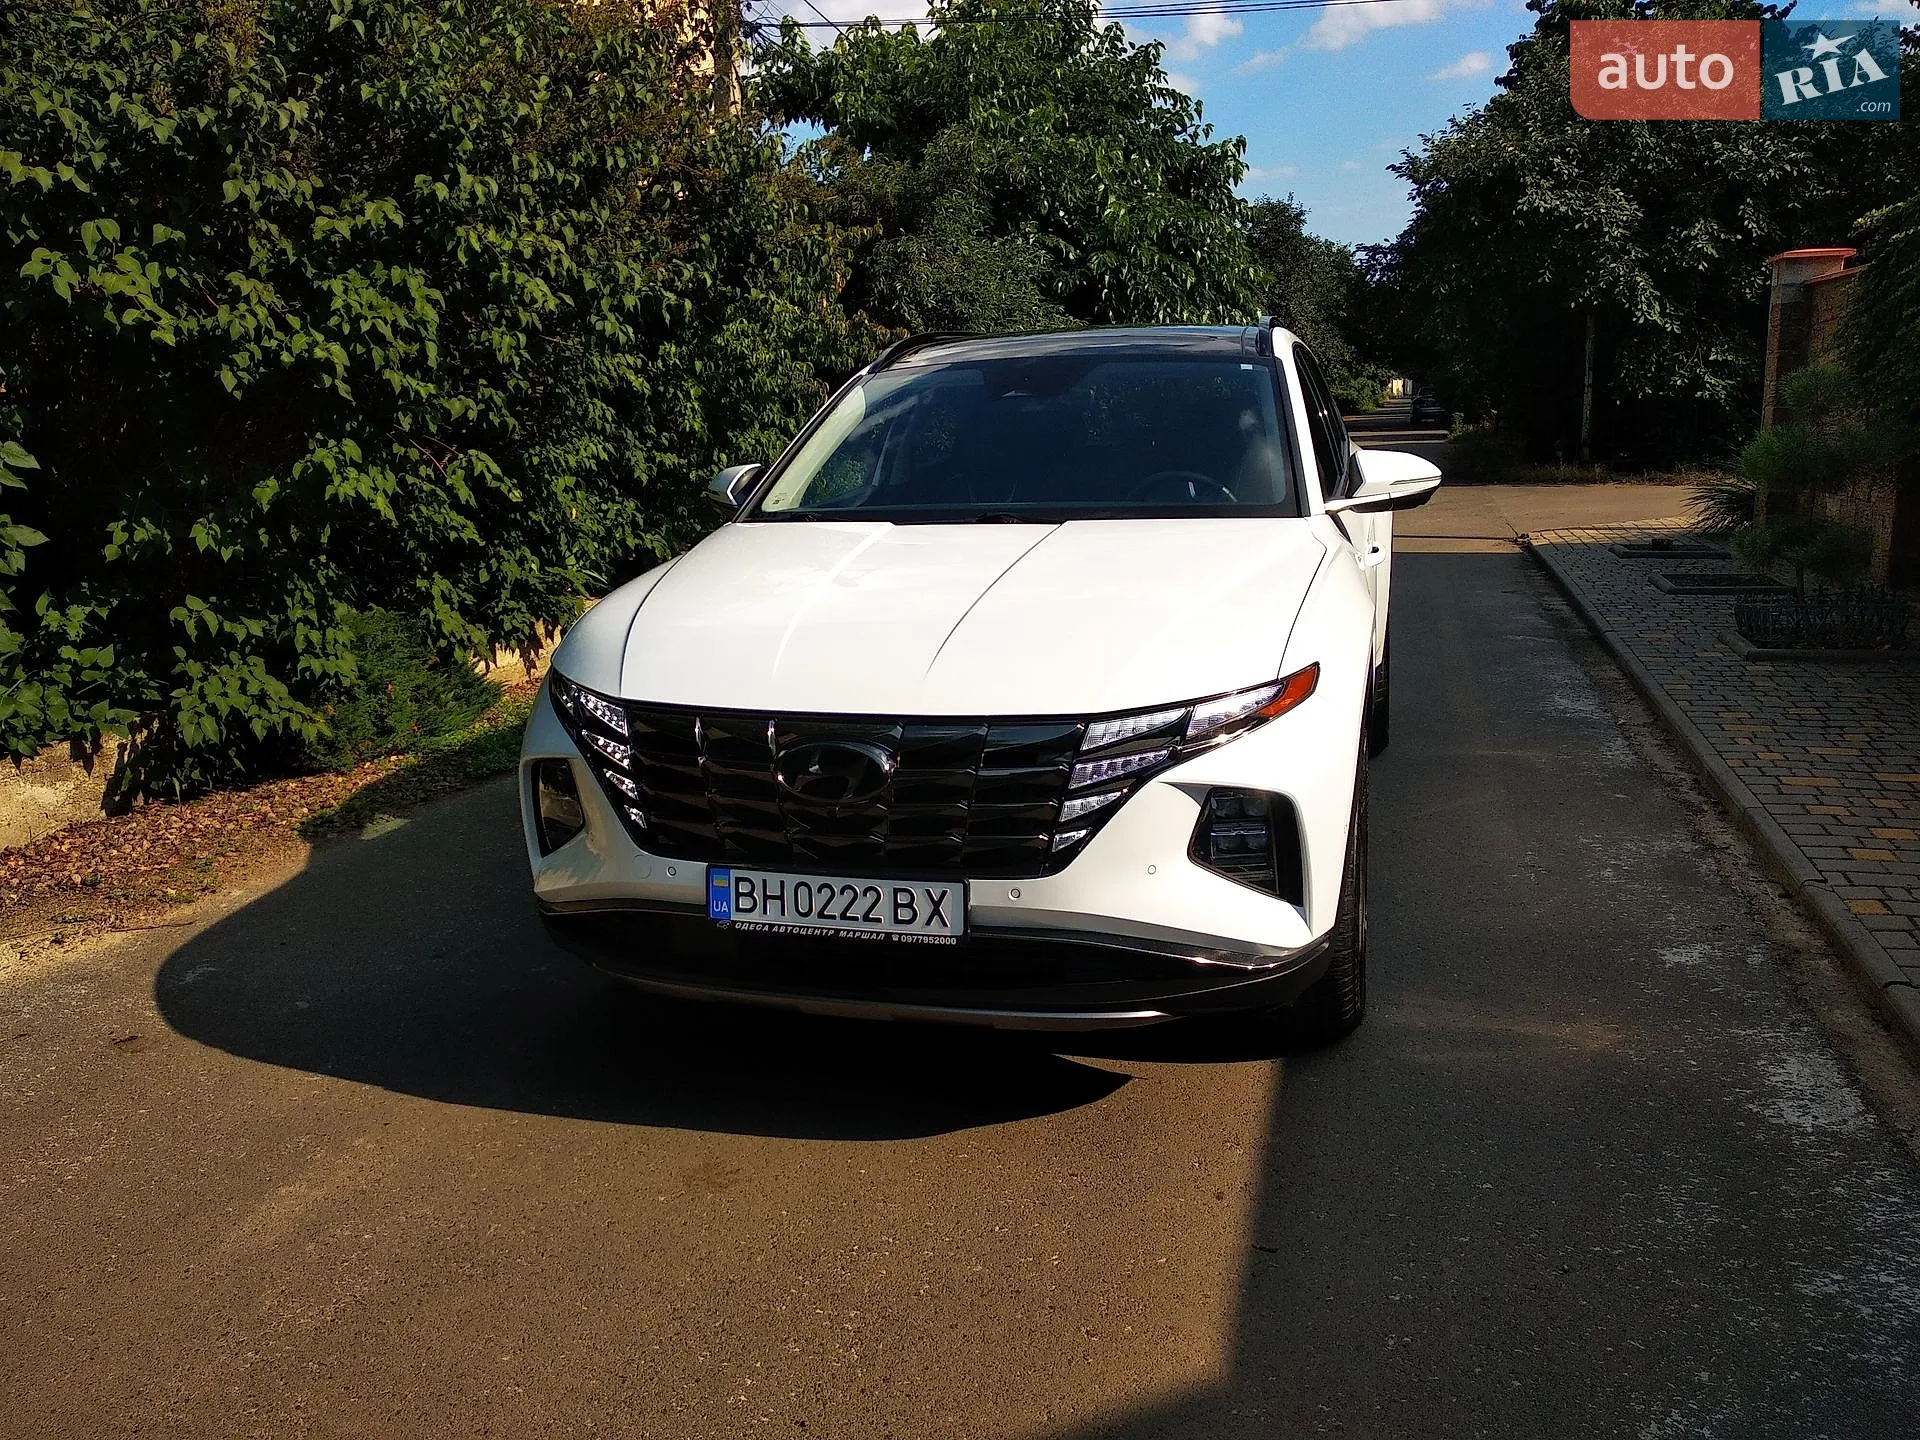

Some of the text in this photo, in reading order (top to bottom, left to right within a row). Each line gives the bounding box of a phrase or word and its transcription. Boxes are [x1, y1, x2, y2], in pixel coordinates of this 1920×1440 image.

[713, 900, 729, 914] UA
[734, 921, 886, 941] ОДЕСА АВТОЦЕНТР МАРШАЛ
[900, 935, 957, 946] 0977952000
